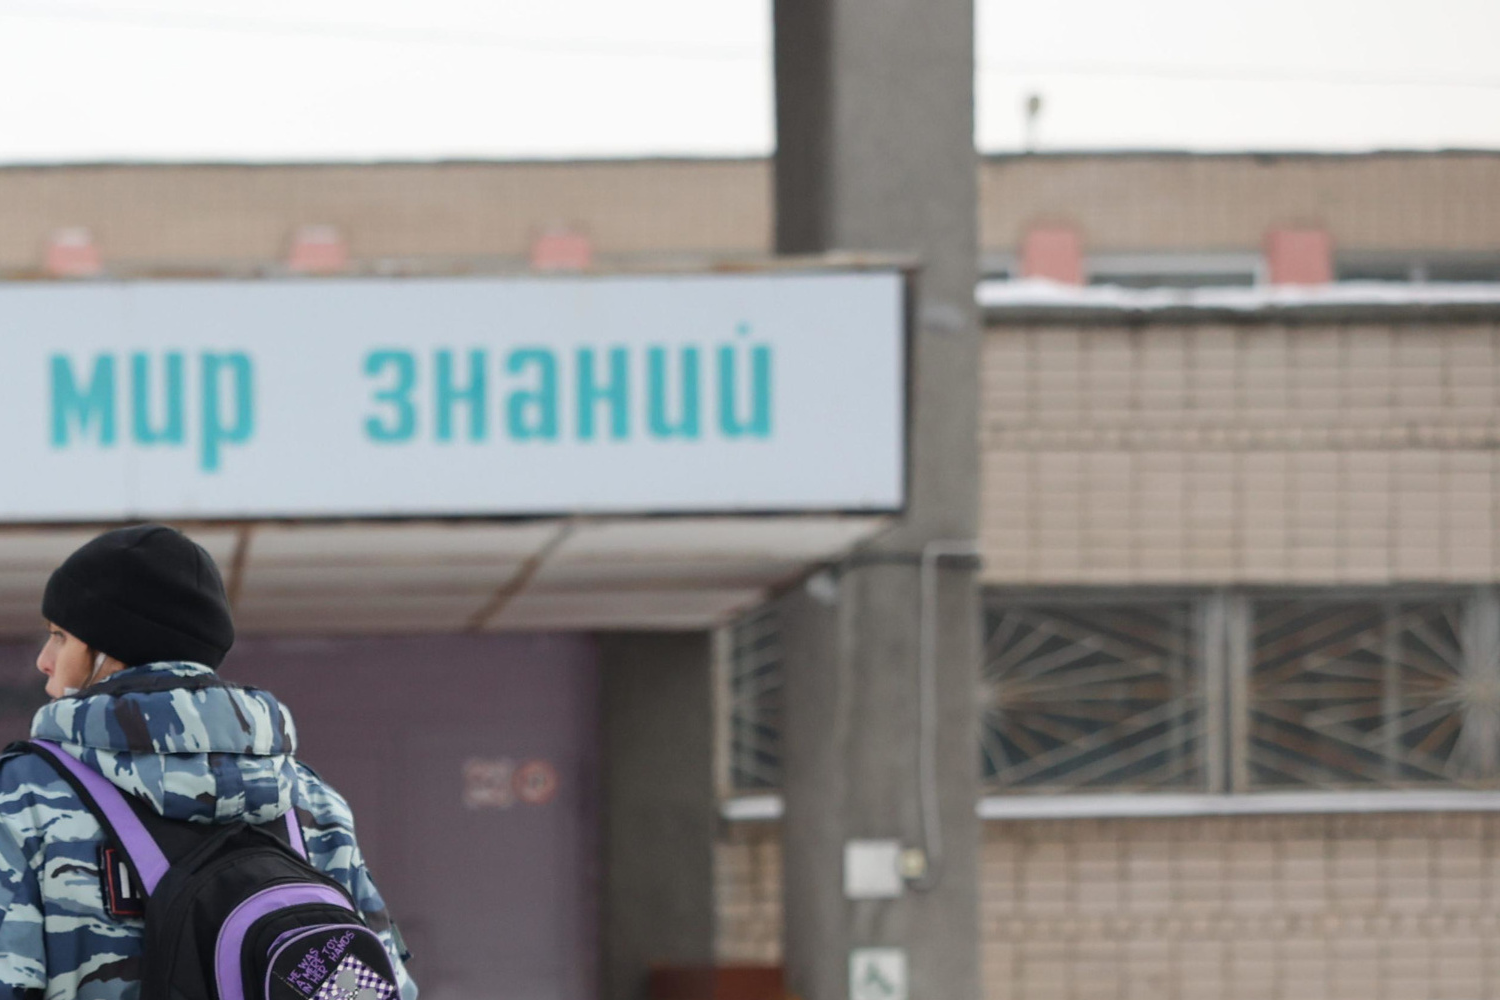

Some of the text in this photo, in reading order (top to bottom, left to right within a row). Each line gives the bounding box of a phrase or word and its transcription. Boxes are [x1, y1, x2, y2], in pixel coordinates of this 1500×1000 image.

[50, 350, 256, 473] мир
[363, 322, 772, 443] знаний
[322, 936, 338, 954] TOY
[287, 947, 319, 983] HE WAS
